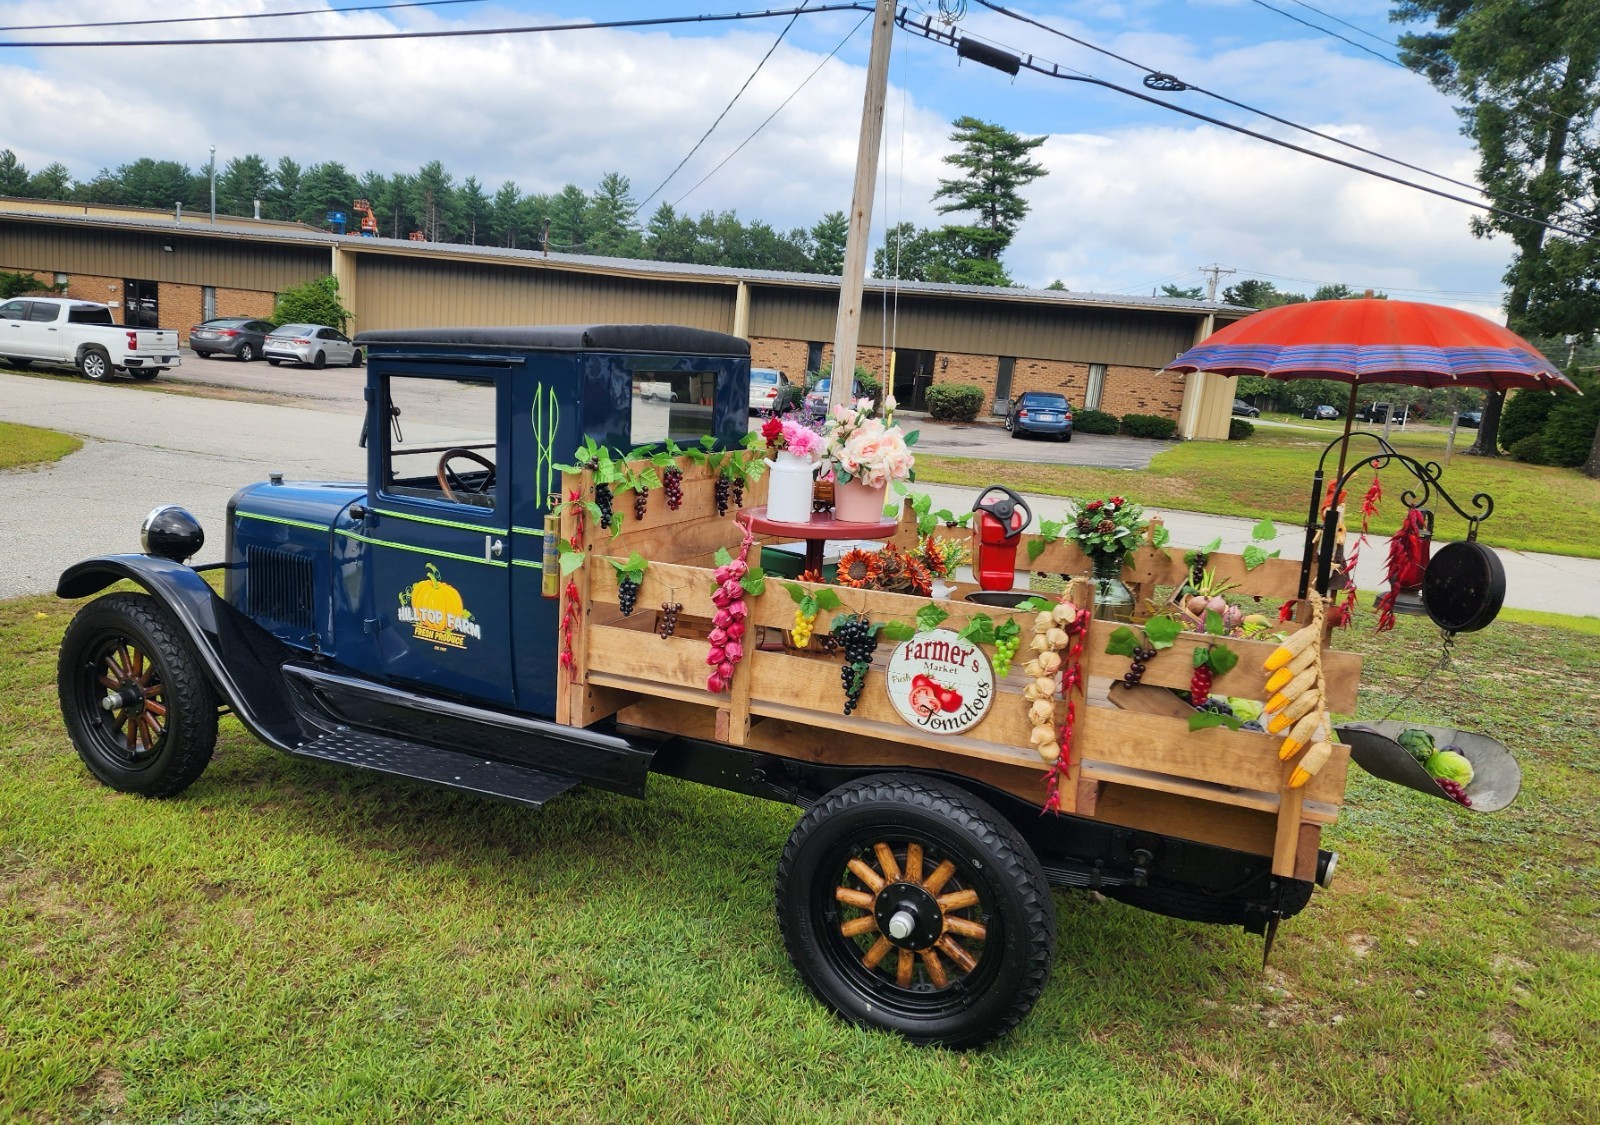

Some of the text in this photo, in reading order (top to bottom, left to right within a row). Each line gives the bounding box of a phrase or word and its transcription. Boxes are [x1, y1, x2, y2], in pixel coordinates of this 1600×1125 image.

[397, 606, 481, 640] HILLTOP FARM
[414, 627, 464, 646] FRESH PRODUCE
[923, 661, 958, 674] Market
[917, 679, 990, 730] Tomatoes
